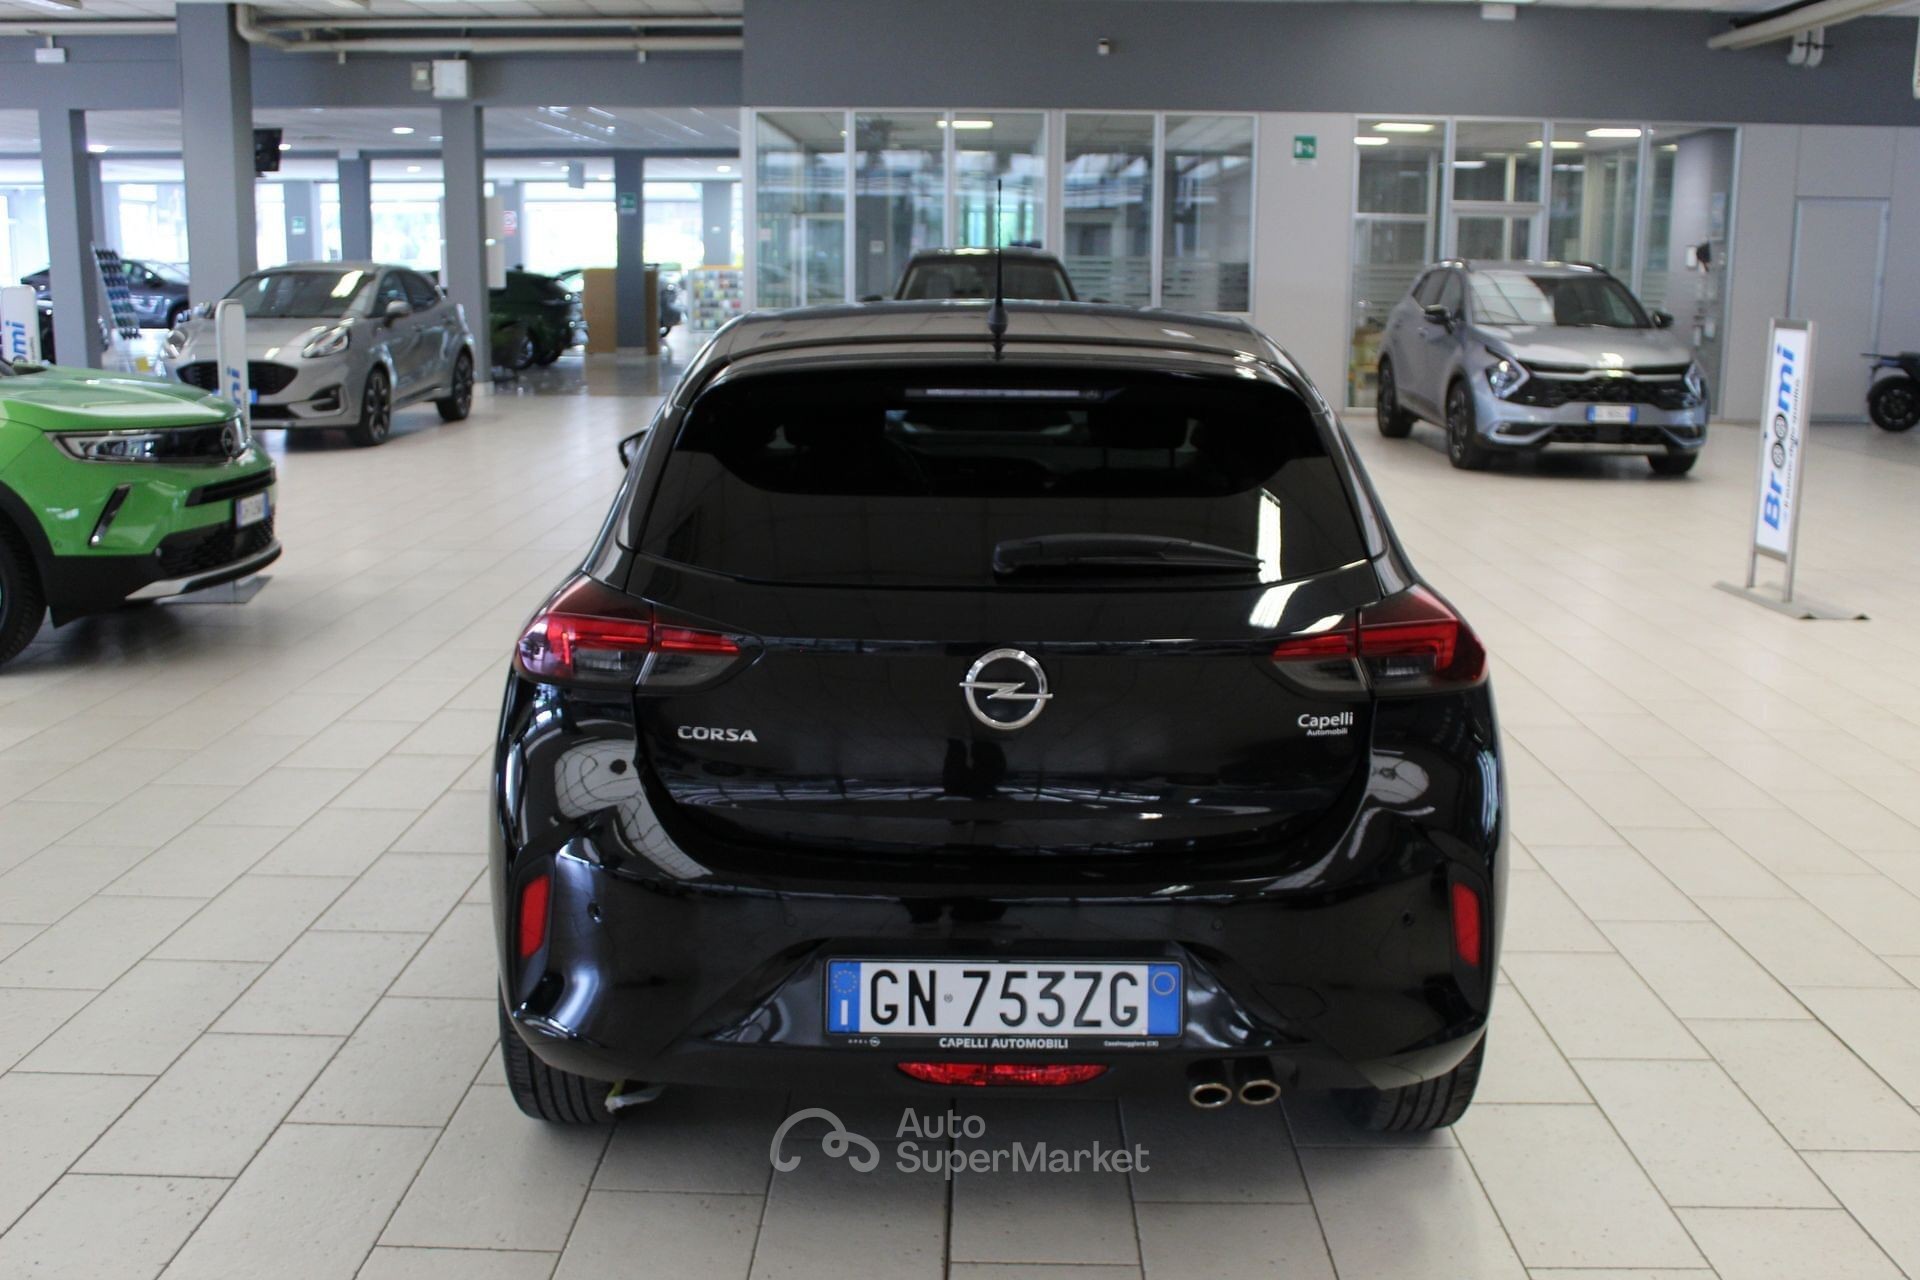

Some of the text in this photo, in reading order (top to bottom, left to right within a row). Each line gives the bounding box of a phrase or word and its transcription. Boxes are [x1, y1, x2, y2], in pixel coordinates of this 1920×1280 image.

[1297, 711, 1354, 729] Capelli
[677, 725, 759, 743] CORSA
[1306, 727, 1349, 736] Automobili
[870, 969, 1139, 1028] GN 753ZG
[939, 1037, 1069, 1049] CAPELLI AUTOMOBILI
